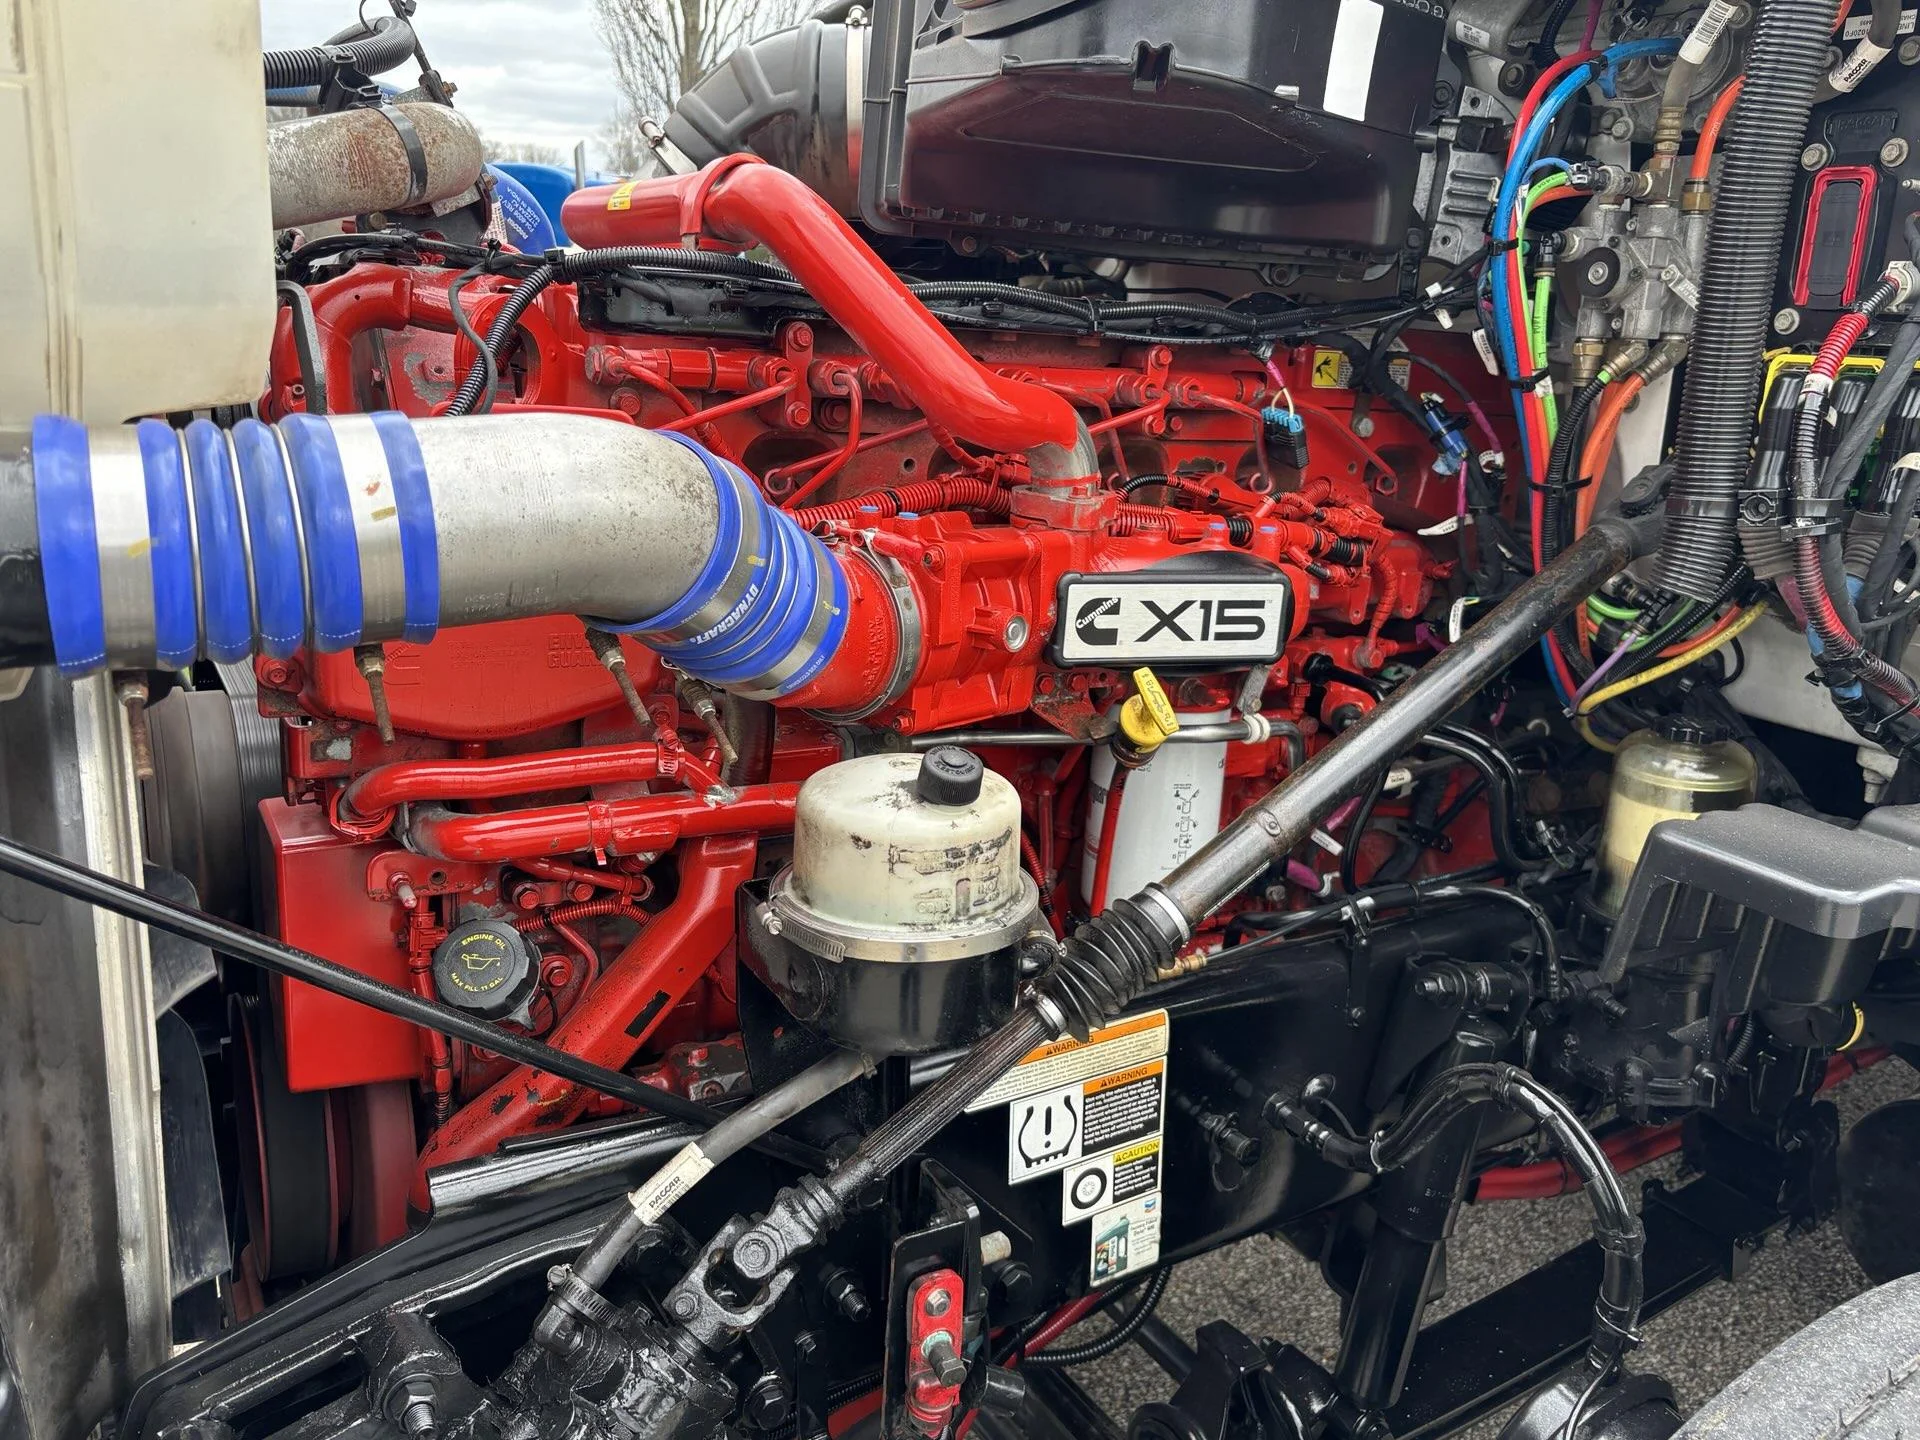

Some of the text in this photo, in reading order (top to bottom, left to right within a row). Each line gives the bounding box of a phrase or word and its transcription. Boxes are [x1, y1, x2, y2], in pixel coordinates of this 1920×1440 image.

[1843, 58, 1868, 82] PACCAR
[526, 206, 541, 223] MADE
[696, 583, 760, 646] DYNACRAFT
[1075, 596, 1119, 629] Cummins
[1133, 600, 1266, 642] X15
[461, 933, 506, 950] ENGINE OIL
[451, 972, 464, 988] MAX
[463, 984, 479, 992] FILL
[489, 976, 503, 988] GAL
[1052, 1035, 1094, 1053] WARNG
[1107, 1068, 1147, 1085] WARNING
[1122, 1142, 1158, 1159] CAUTION
[648, 1176, 681, 1208] PACCAR
